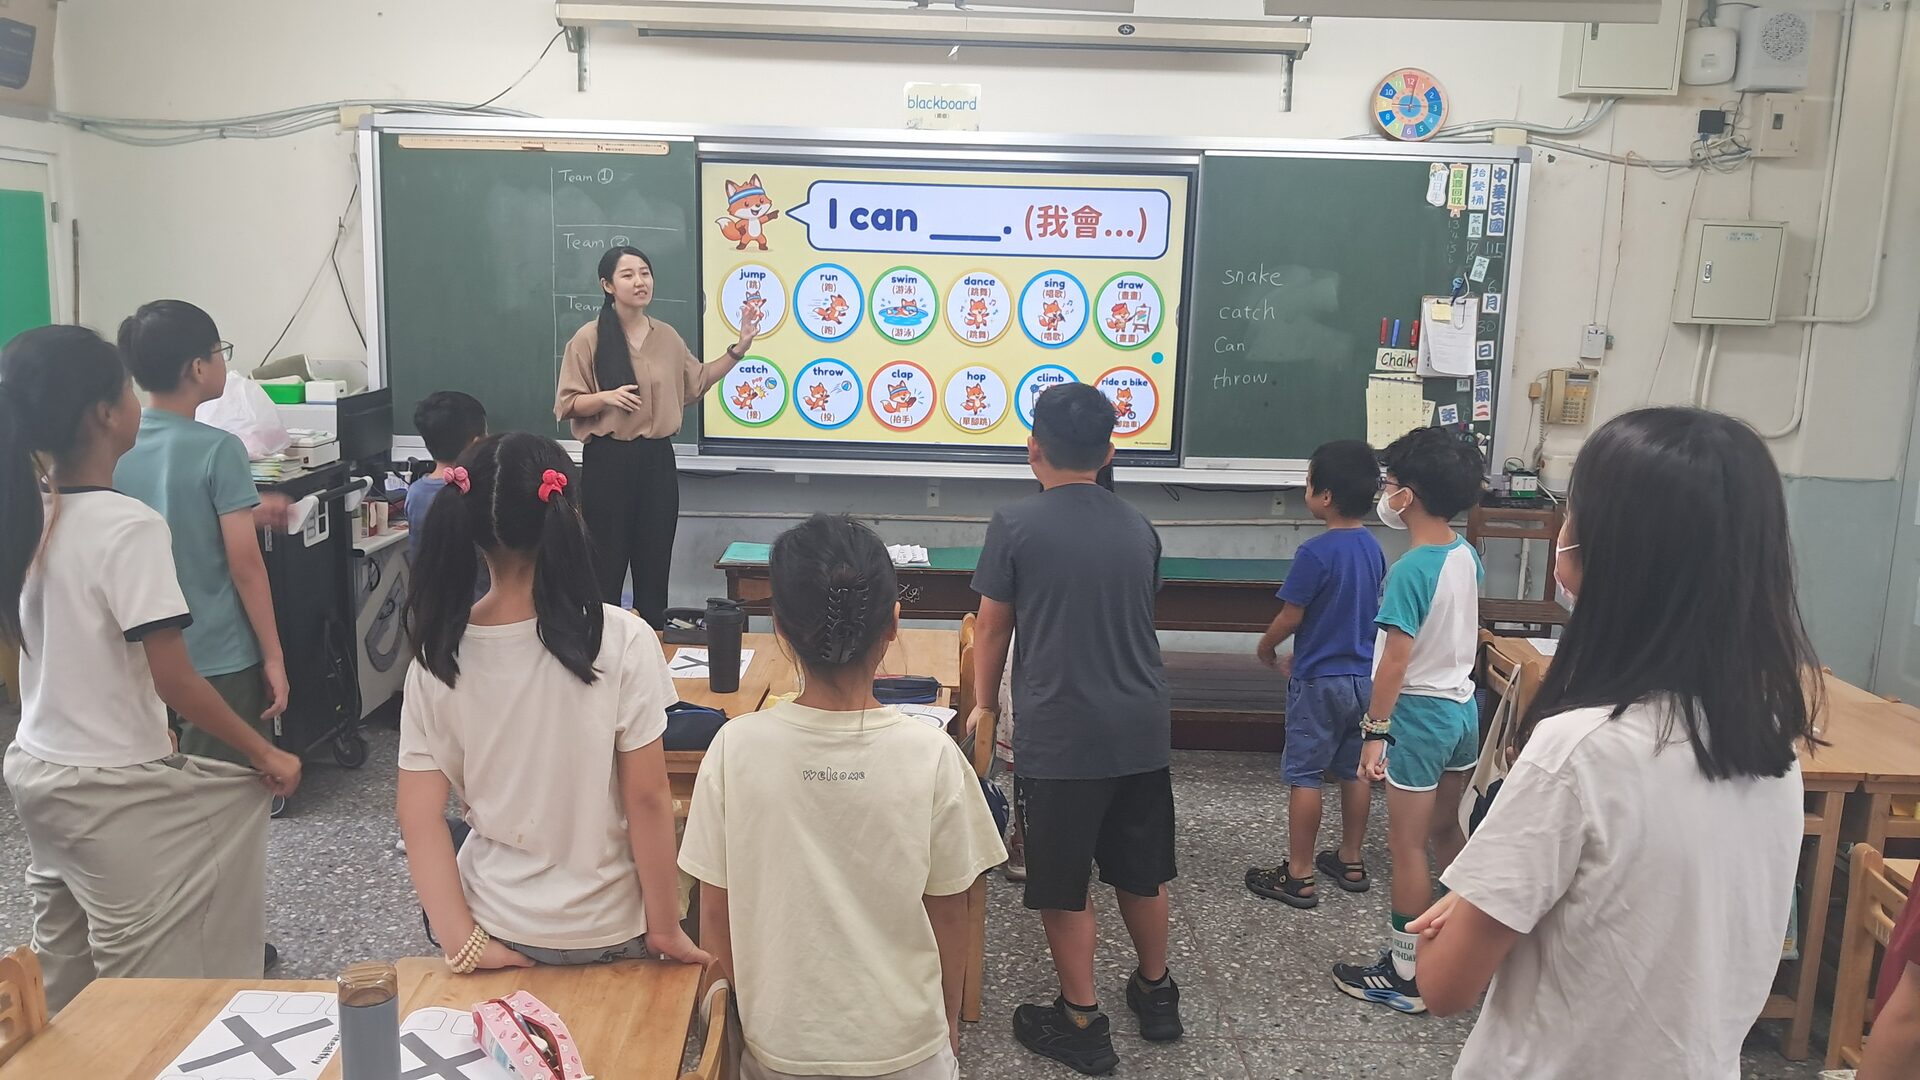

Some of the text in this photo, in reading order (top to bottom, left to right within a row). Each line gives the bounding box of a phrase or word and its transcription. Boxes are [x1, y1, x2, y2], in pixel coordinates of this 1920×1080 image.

[908, 94, 977, 110] blackboard
[558, 170, 592, 182] Team
[1489, 167, 1507, 233] 中華民國
[830, 198, 837, 229] I
[850, 207, 917, 232] can
[563, 233, 604, 249] Team
[740, 269, 766, 280] jump
[892, 275, 917, 284] swim
[1222, 262, 1283, 286] snake
[746, 281, 761, 290] (跳)
[964, 277, 995, 286] dance
[1044, 279, 1065, 290] sing
[1117, 280, 1143, 289] draw
[1488, 280, 1496, 294] 6
[822, 283, 836, 292] (跑)
[892, 285, 916, 295] (游泳)
[968, 288, 991, 297] (跳舞)
[1043, 290, 1066, 299] (唱歌)
[566, 296, 602, 311] Team
[1486, 295, 1497, 311] 月
[1220, 299, 1275, 320] catch
[821, 326, 836, 335] (跑)
[891, 328, 915, 337] (游泳)
[1214, 336, 1245, 353] Can
[1479, 344, 1492, 358] 日
[1381, 351, 1414, 367] Chalk
[740, 365, 768, 374] catch
[813, 367, 843, 376] throw
[892, 369, 913, 380] clap
[967, 372, 986, 382] hop
[1037, 373, 1064, 382] climb
[1102, 378, 1119, 386] ride
[1130, 378, 1148, 387] bike
[1214, 368, 1267, 389] throw
[1474, 371, 1490, 417] 星期二
[890, 415, 913, 424] (拍手)
[802, 766, 865, 781] welcome
[311, 1031, 340, 1064] nhealthy
